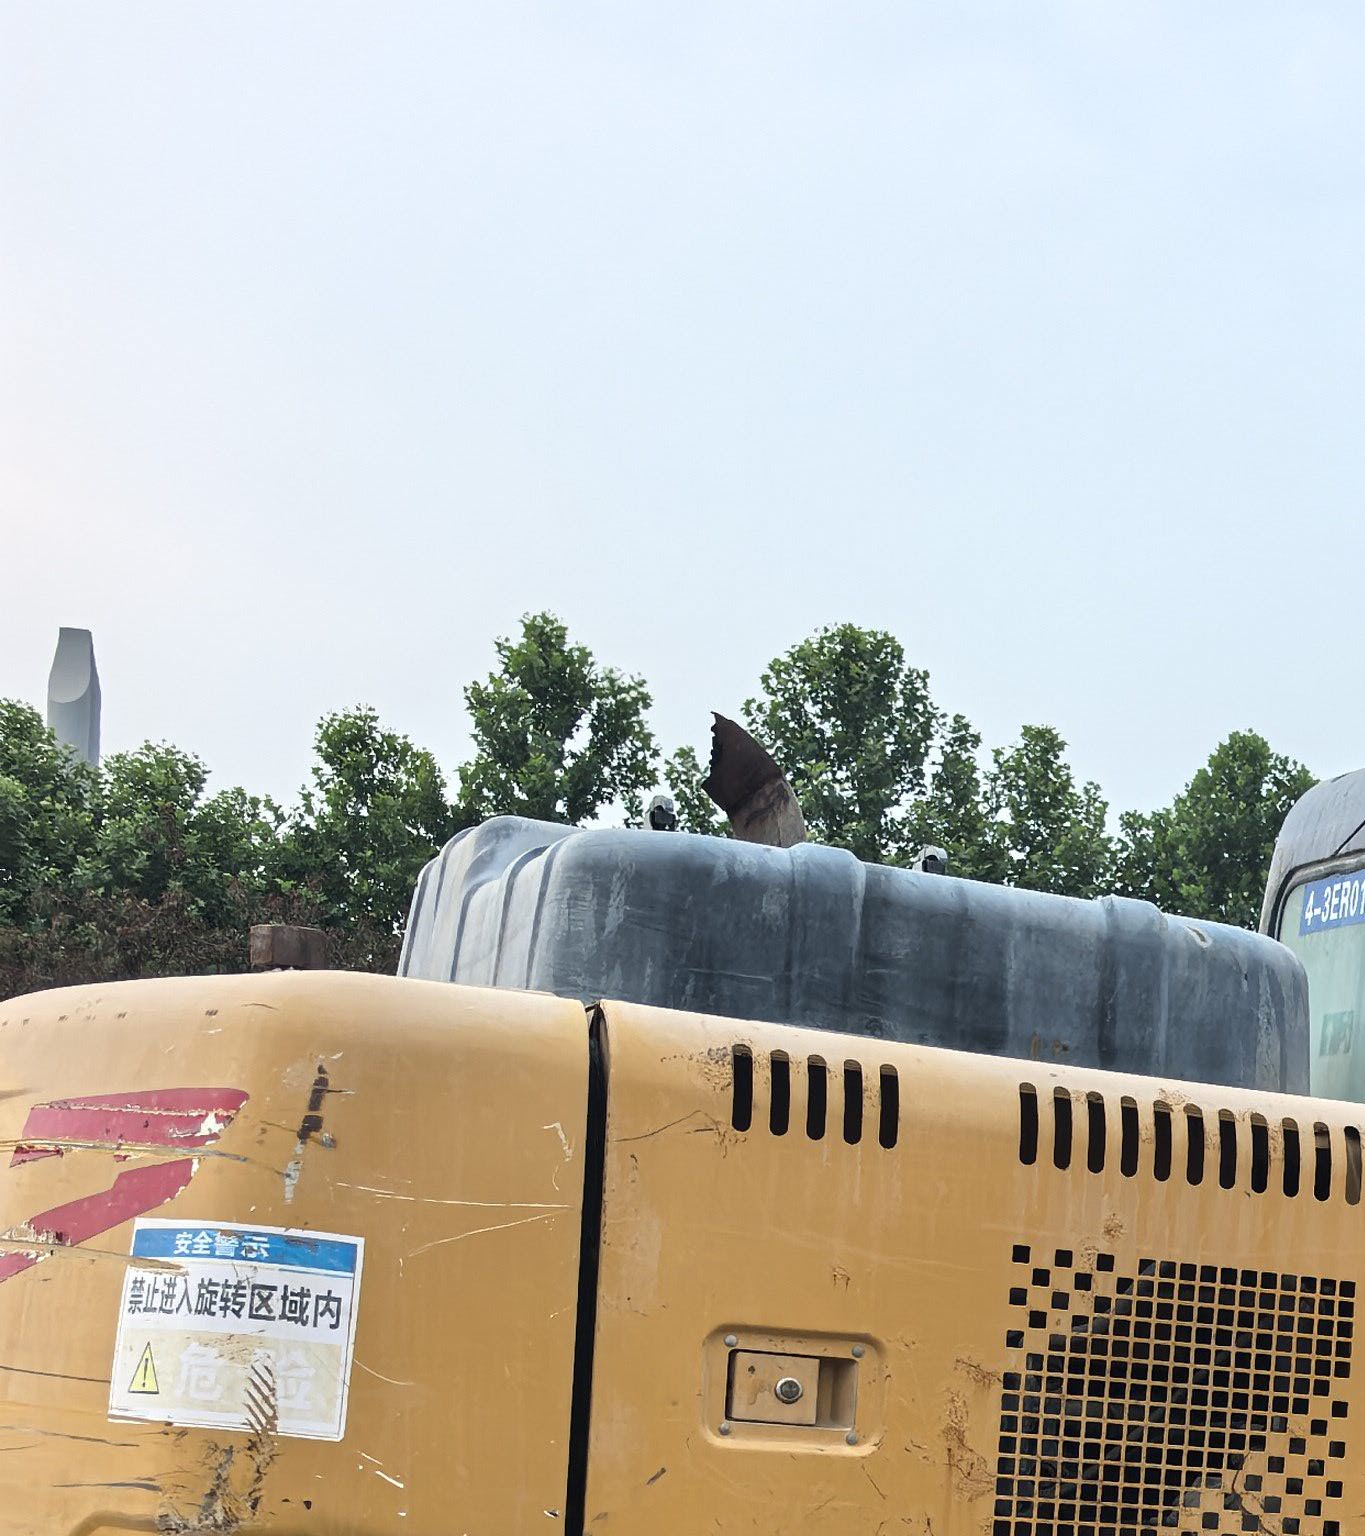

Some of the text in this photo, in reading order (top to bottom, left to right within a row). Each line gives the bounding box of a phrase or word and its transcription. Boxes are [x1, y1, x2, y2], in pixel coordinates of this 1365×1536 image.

[173, 1230, 270, 1259] 安全警示
[127, 1275, 343, 1330] 禁止进入旋转区域内
